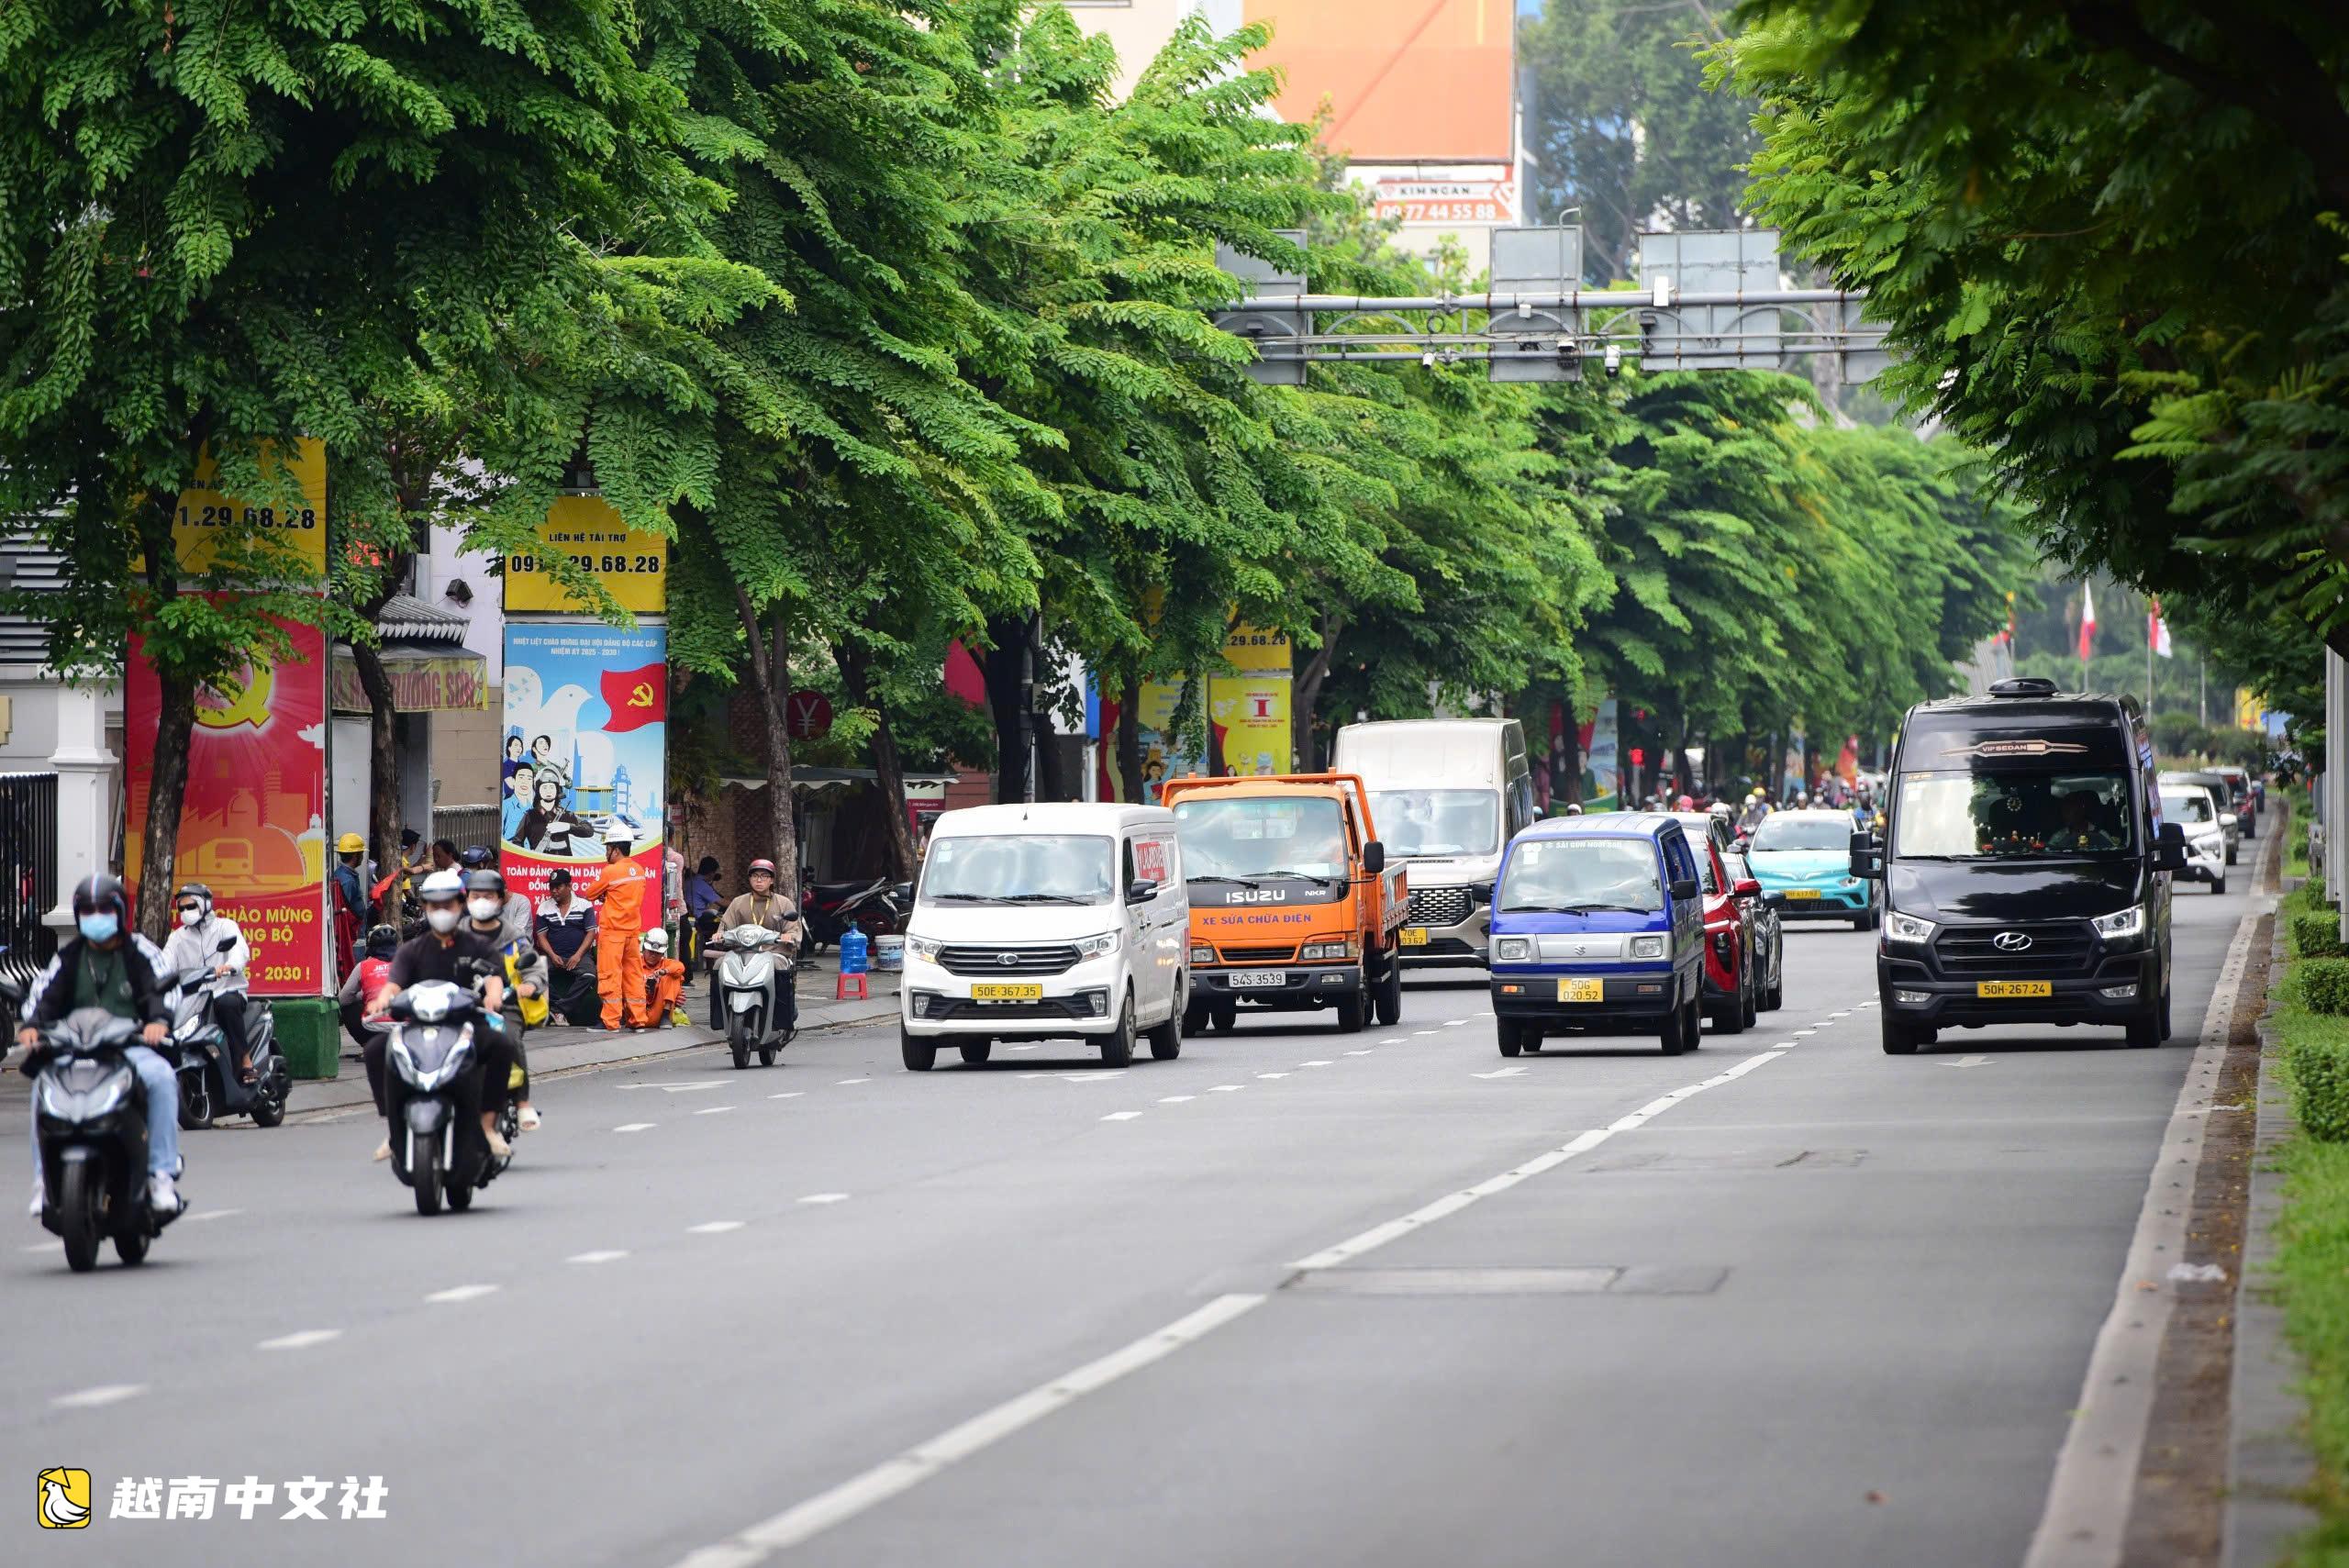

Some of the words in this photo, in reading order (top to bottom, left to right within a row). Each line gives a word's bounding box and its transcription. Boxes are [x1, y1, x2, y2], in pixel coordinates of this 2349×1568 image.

[1405, 204, 1425, 220] 77
[1429, 204, 1449, 220] 44
[1453, 204, 1472, 220] 55
[549, 533, 571, 542] LIÊN
[573, 532, 585, 543] HỆ
[589, 533, 605, 542] TÀI
[608, 533, 627, 543] TRỢ
[506, 865, 528, 876] TOÀN
[1226, 890, 1285, 904] ISUZU
[266, 906, 314, 923] MỪNG
[1203, 917, 1216, 926] XE
[271, 925, 294, 946] BỘ
[264, 966, 302, 981] 2030
